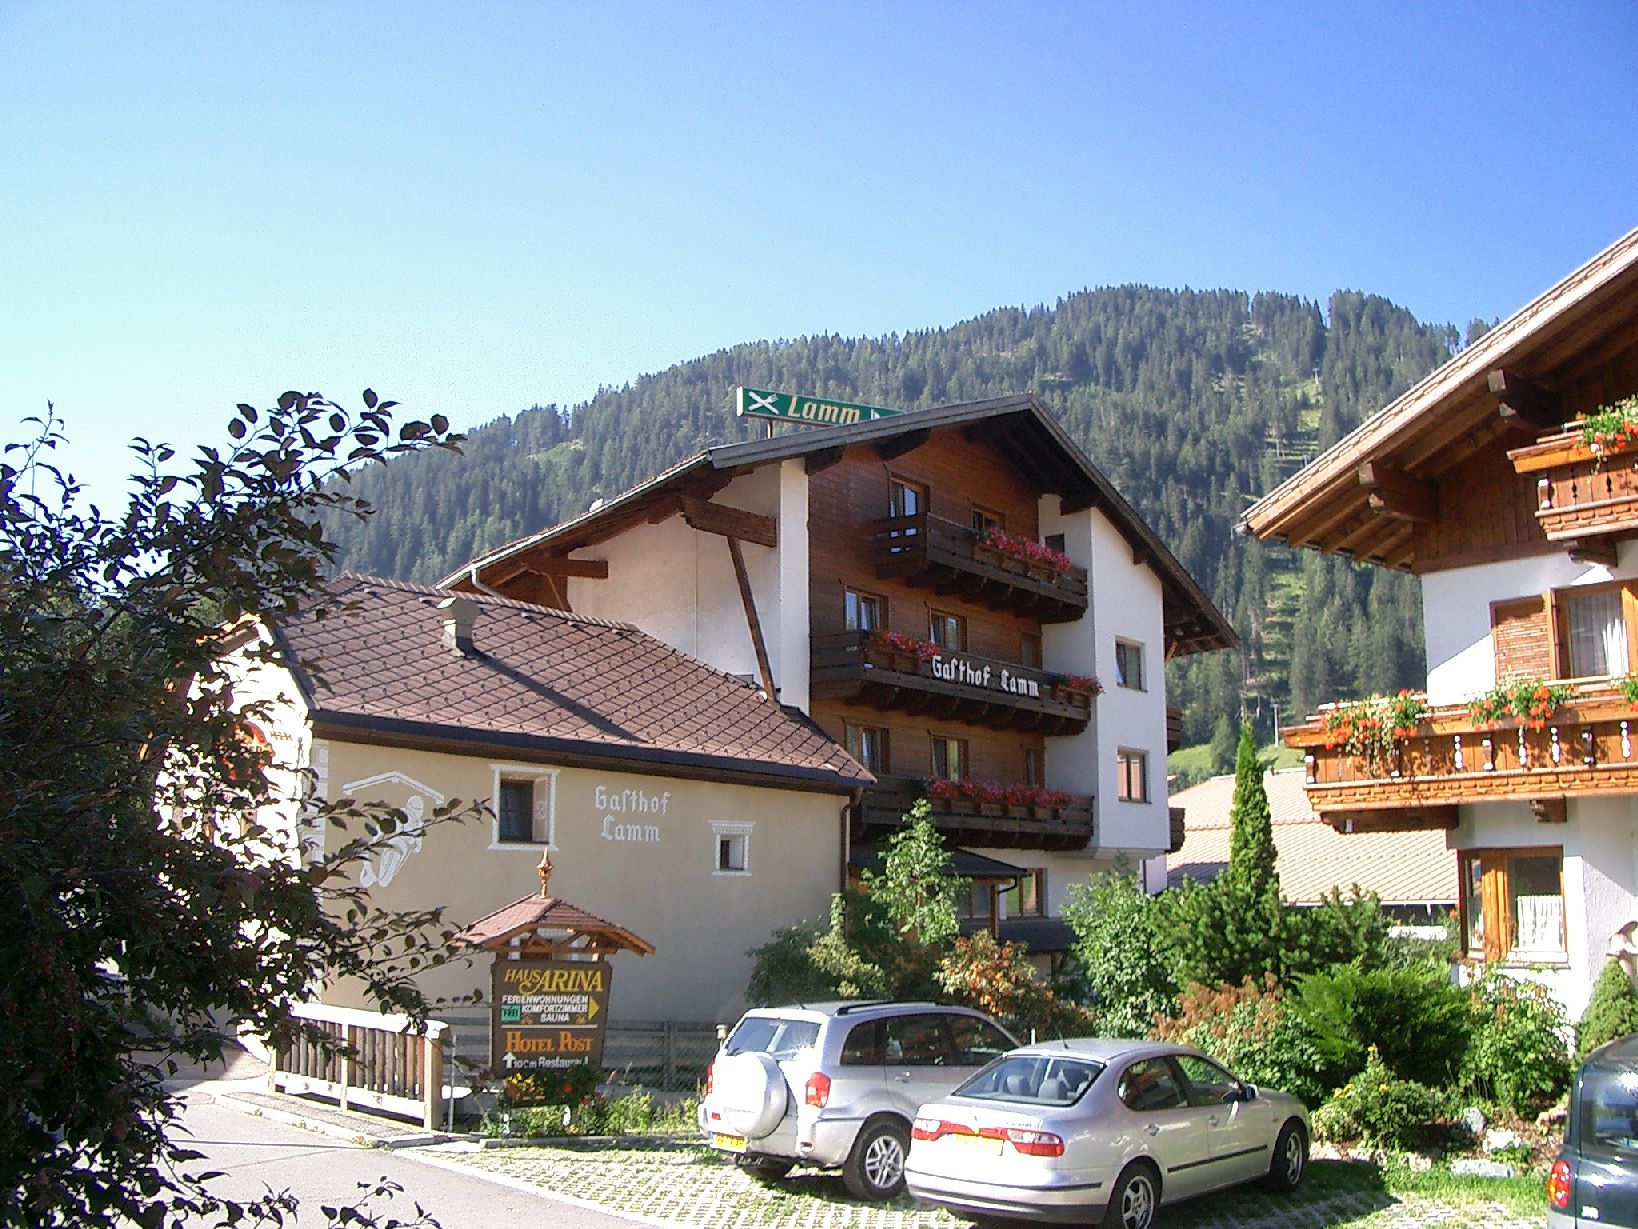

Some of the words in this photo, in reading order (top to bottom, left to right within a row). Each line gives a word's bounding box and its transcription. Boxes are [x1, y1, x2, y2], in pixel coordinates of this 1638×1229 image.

[787, 396, 860, 424] Lamm
[1001, 668, 1040, 697] Lamm
[601, 814, 661, 841] Lamm
[502, 995, 589, 1005] FERIENWOHNUNGEN
[540, 1012, 570, 1022] SAUNA
